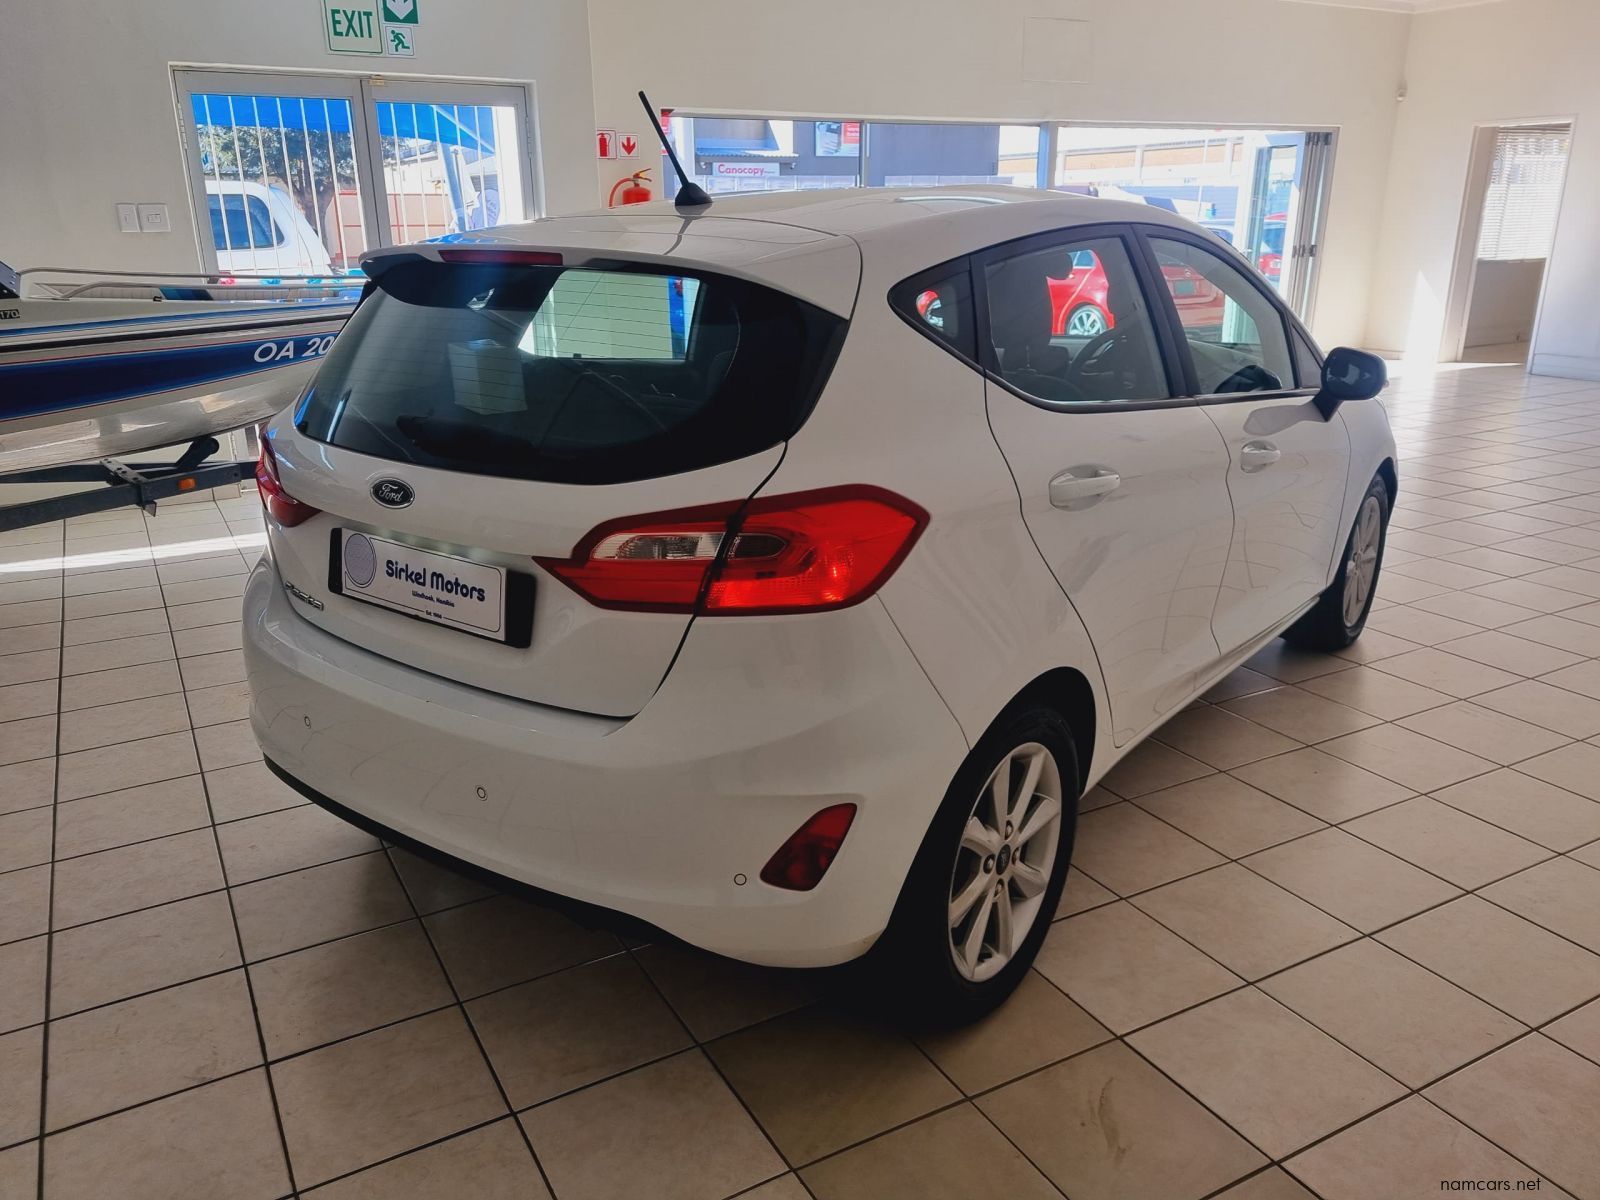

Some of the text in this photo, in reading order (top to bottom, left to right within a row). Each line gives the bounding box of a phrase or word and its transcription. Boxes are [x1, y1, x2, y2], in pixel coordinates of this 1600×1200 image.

[330, 9, 373, 39] EXIT
[718, 163, 765, 176] Canocopy
[253, 340, 295, 363] OA
[378, 483, 404, 502] Ford
[385, 559, 486, 602] Sirkel Motors
